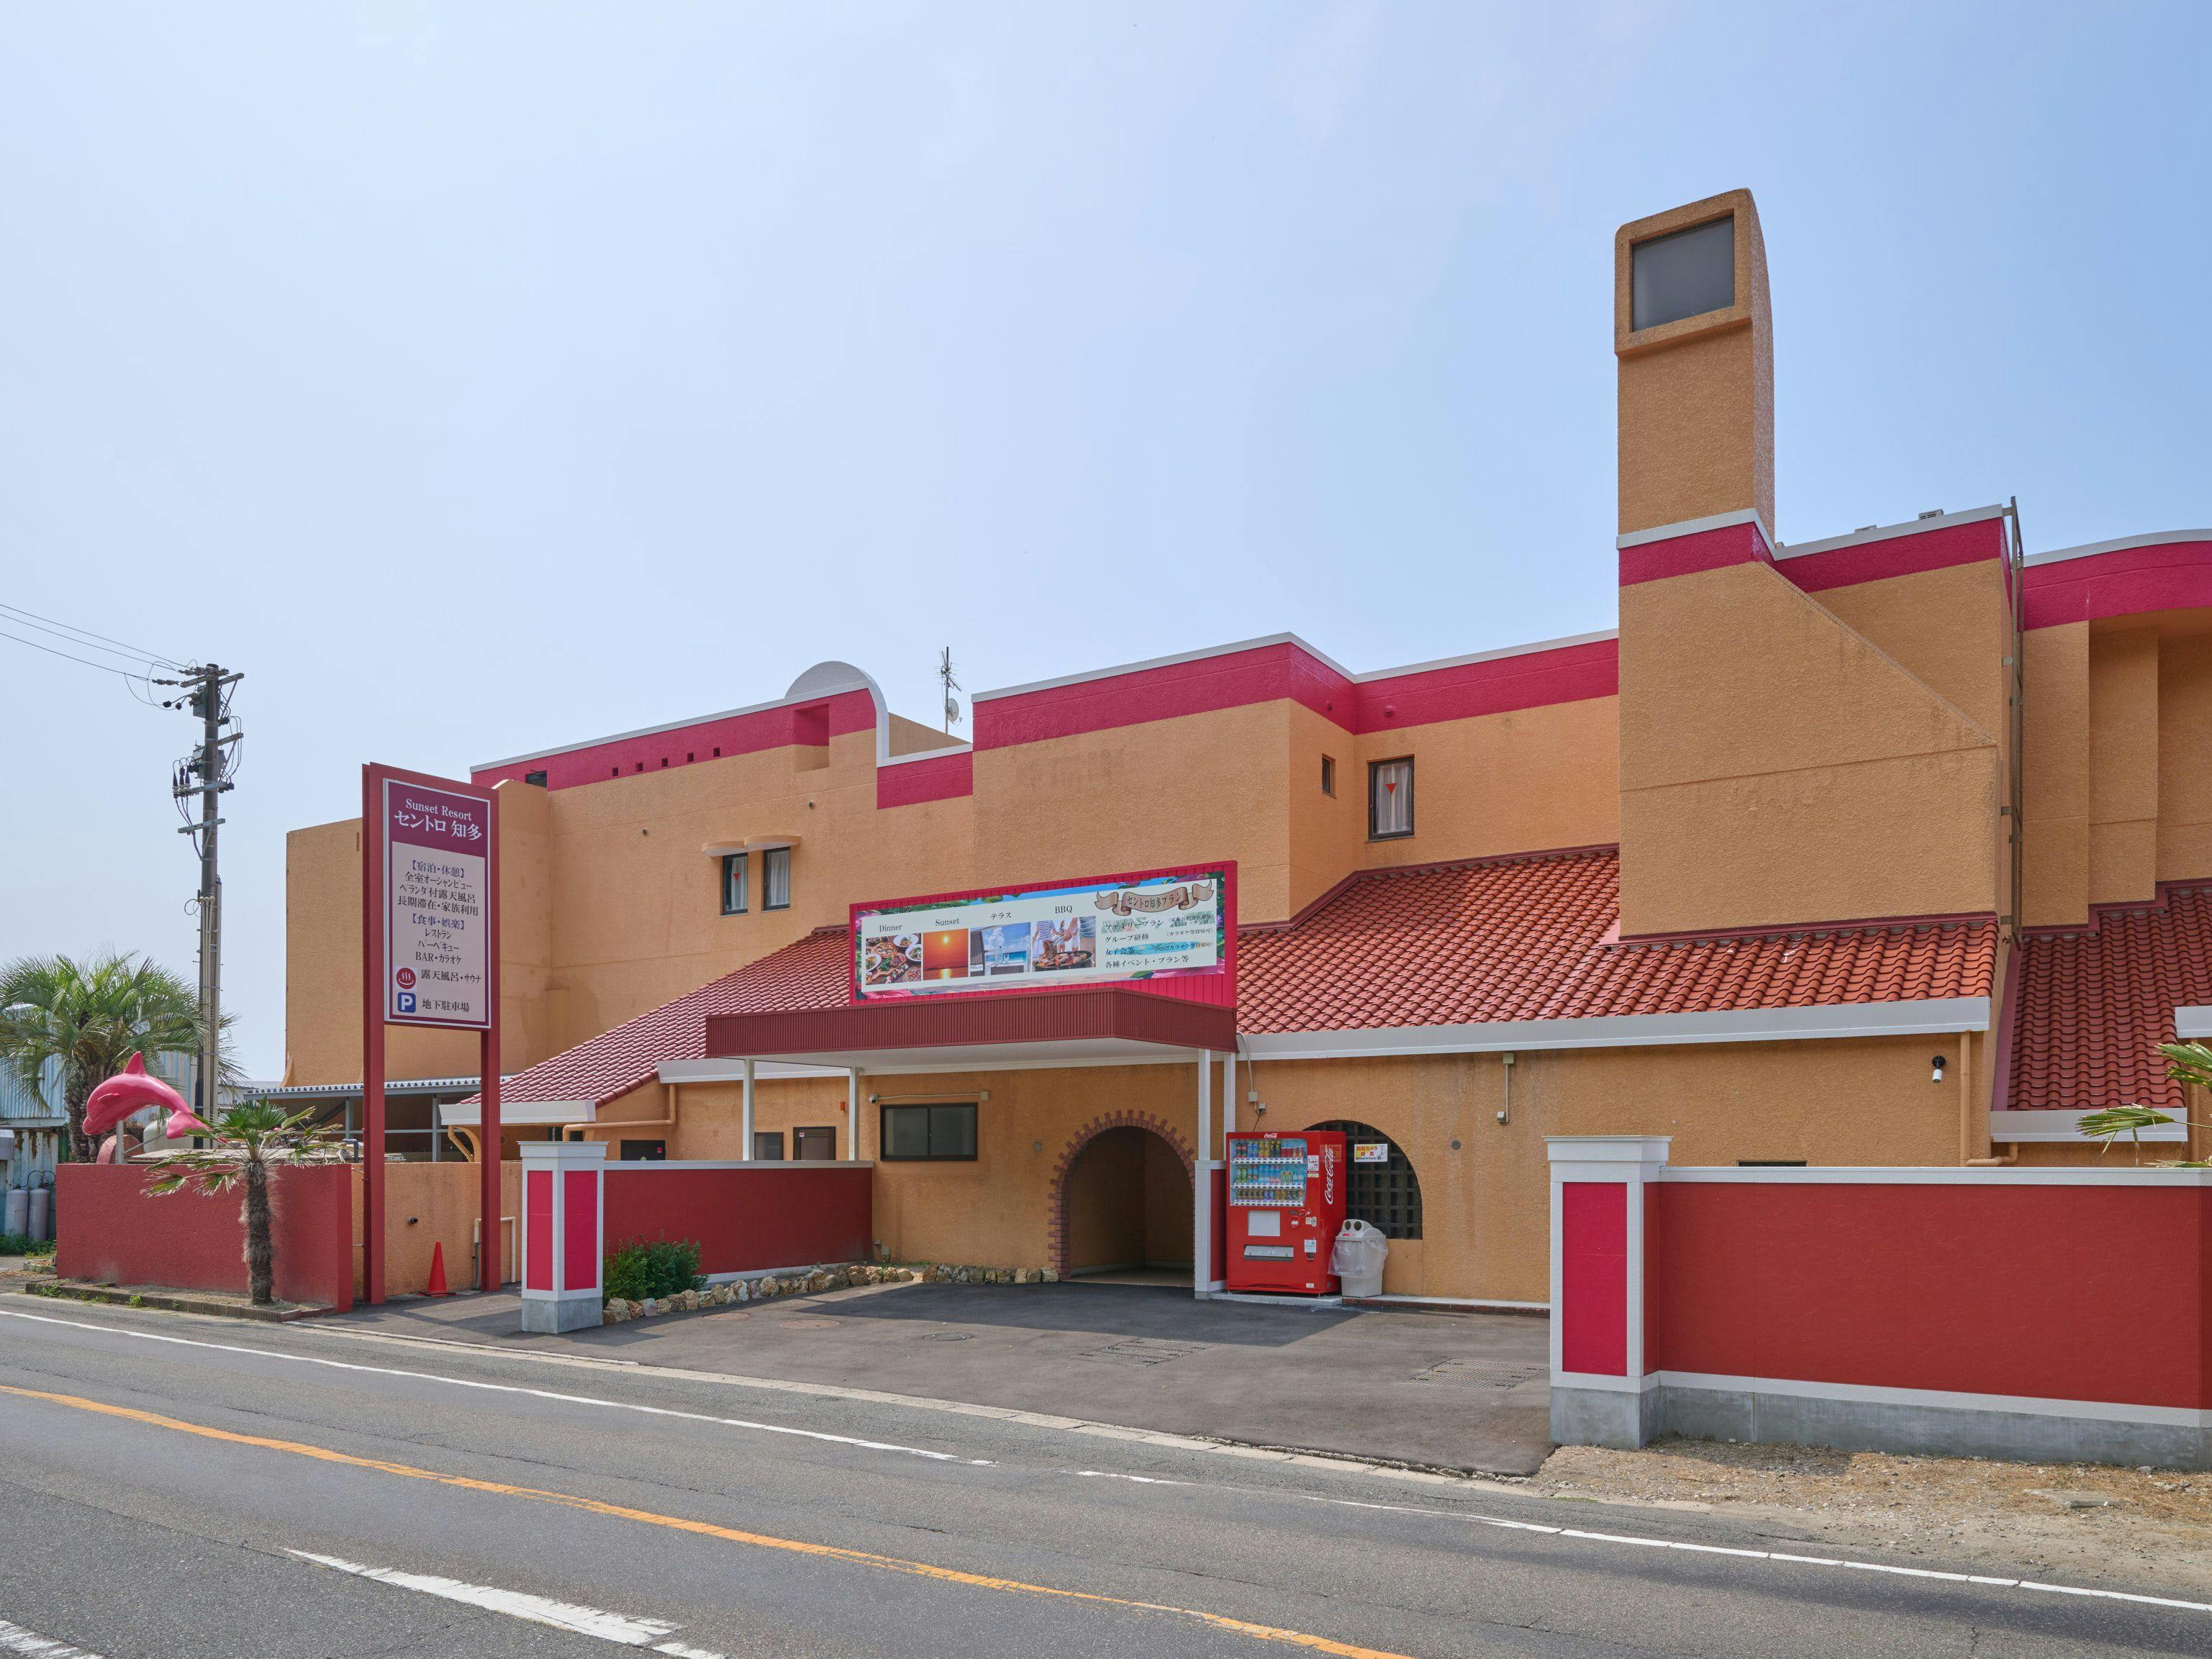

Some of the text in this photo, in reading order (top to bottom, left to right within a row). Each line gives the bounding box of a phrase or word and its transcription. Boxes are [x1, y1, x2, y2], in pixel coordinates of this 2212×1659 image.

[405, 798, 472, 821] Sunset Resort
[394, 810, 482, 840] セントロ 知多
[404, 871, 472, 889] 全室オーシャンビュー
[400, 884, 476, 904] ベランダ付露天風呂
[397, 896, 479, 916] 長期滞在・家族利用
[1054, 904, 1073, 914] BBQ
[879, 924, 902, 932] Dinner
[935, 917, 960, 927] Sunset
[425, 928, 452, 939] レストラン
[1105, 933, 1149, 943] グループ研修
[418, 940, 460, 952] バーベキュー
[421, 969, 481, 983] 露天風呂・サウナ
[401, 994, 413, 1010] P
[422, 999, 470, 1012] 地下駐車場
